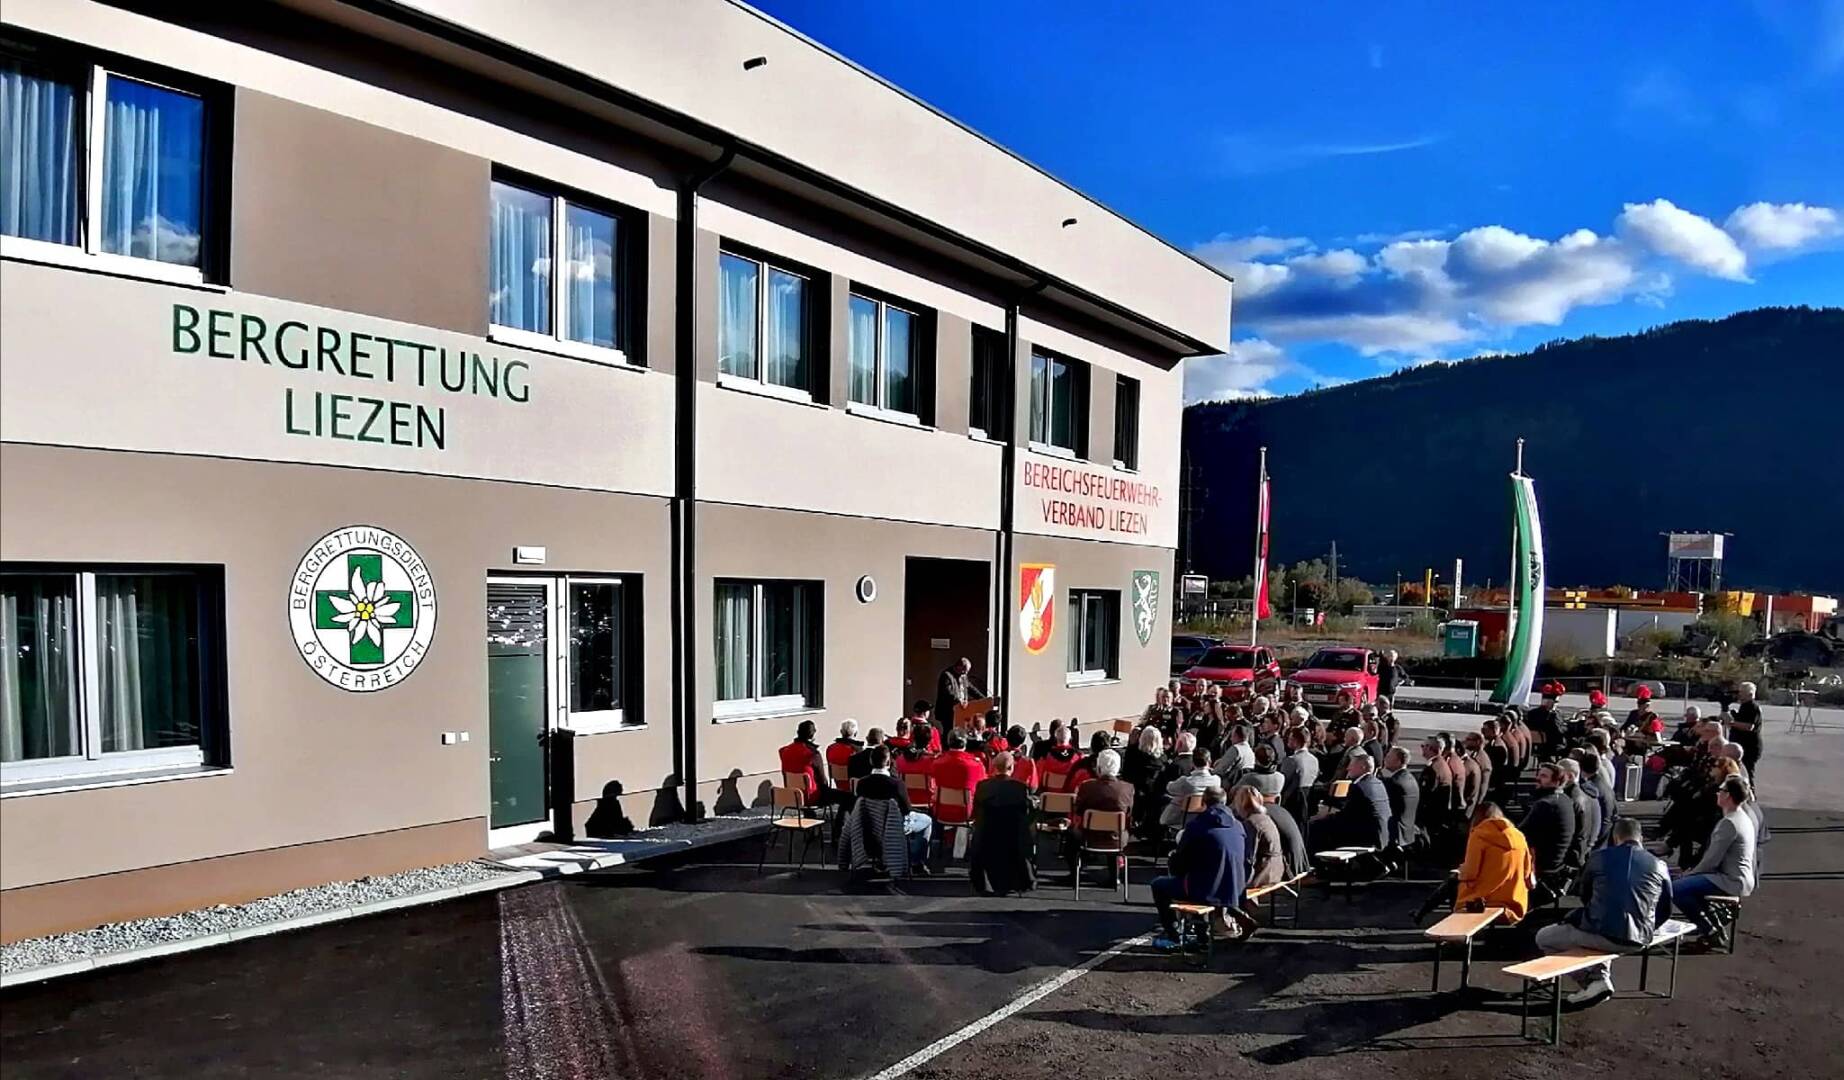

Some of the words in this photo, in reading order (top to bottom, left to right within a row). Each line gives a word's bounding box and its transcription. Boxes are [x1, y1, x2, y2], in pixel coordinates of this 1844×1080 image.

[172, 303, 530, 403] BERGRETTUNG
[285, 387, 445, 450] LIEZEN
[1024, 461, 1163, 508] BEREICHSFEUERWEHR-
[1042, 498, 1105, 530] VERBAND
[1109, 509, 1148, 536] LIEZEN
[293, 530, 434, 611] BERGRETTUNGSDIENST
[303, 639, 425, 688] ÖSTERREICH
